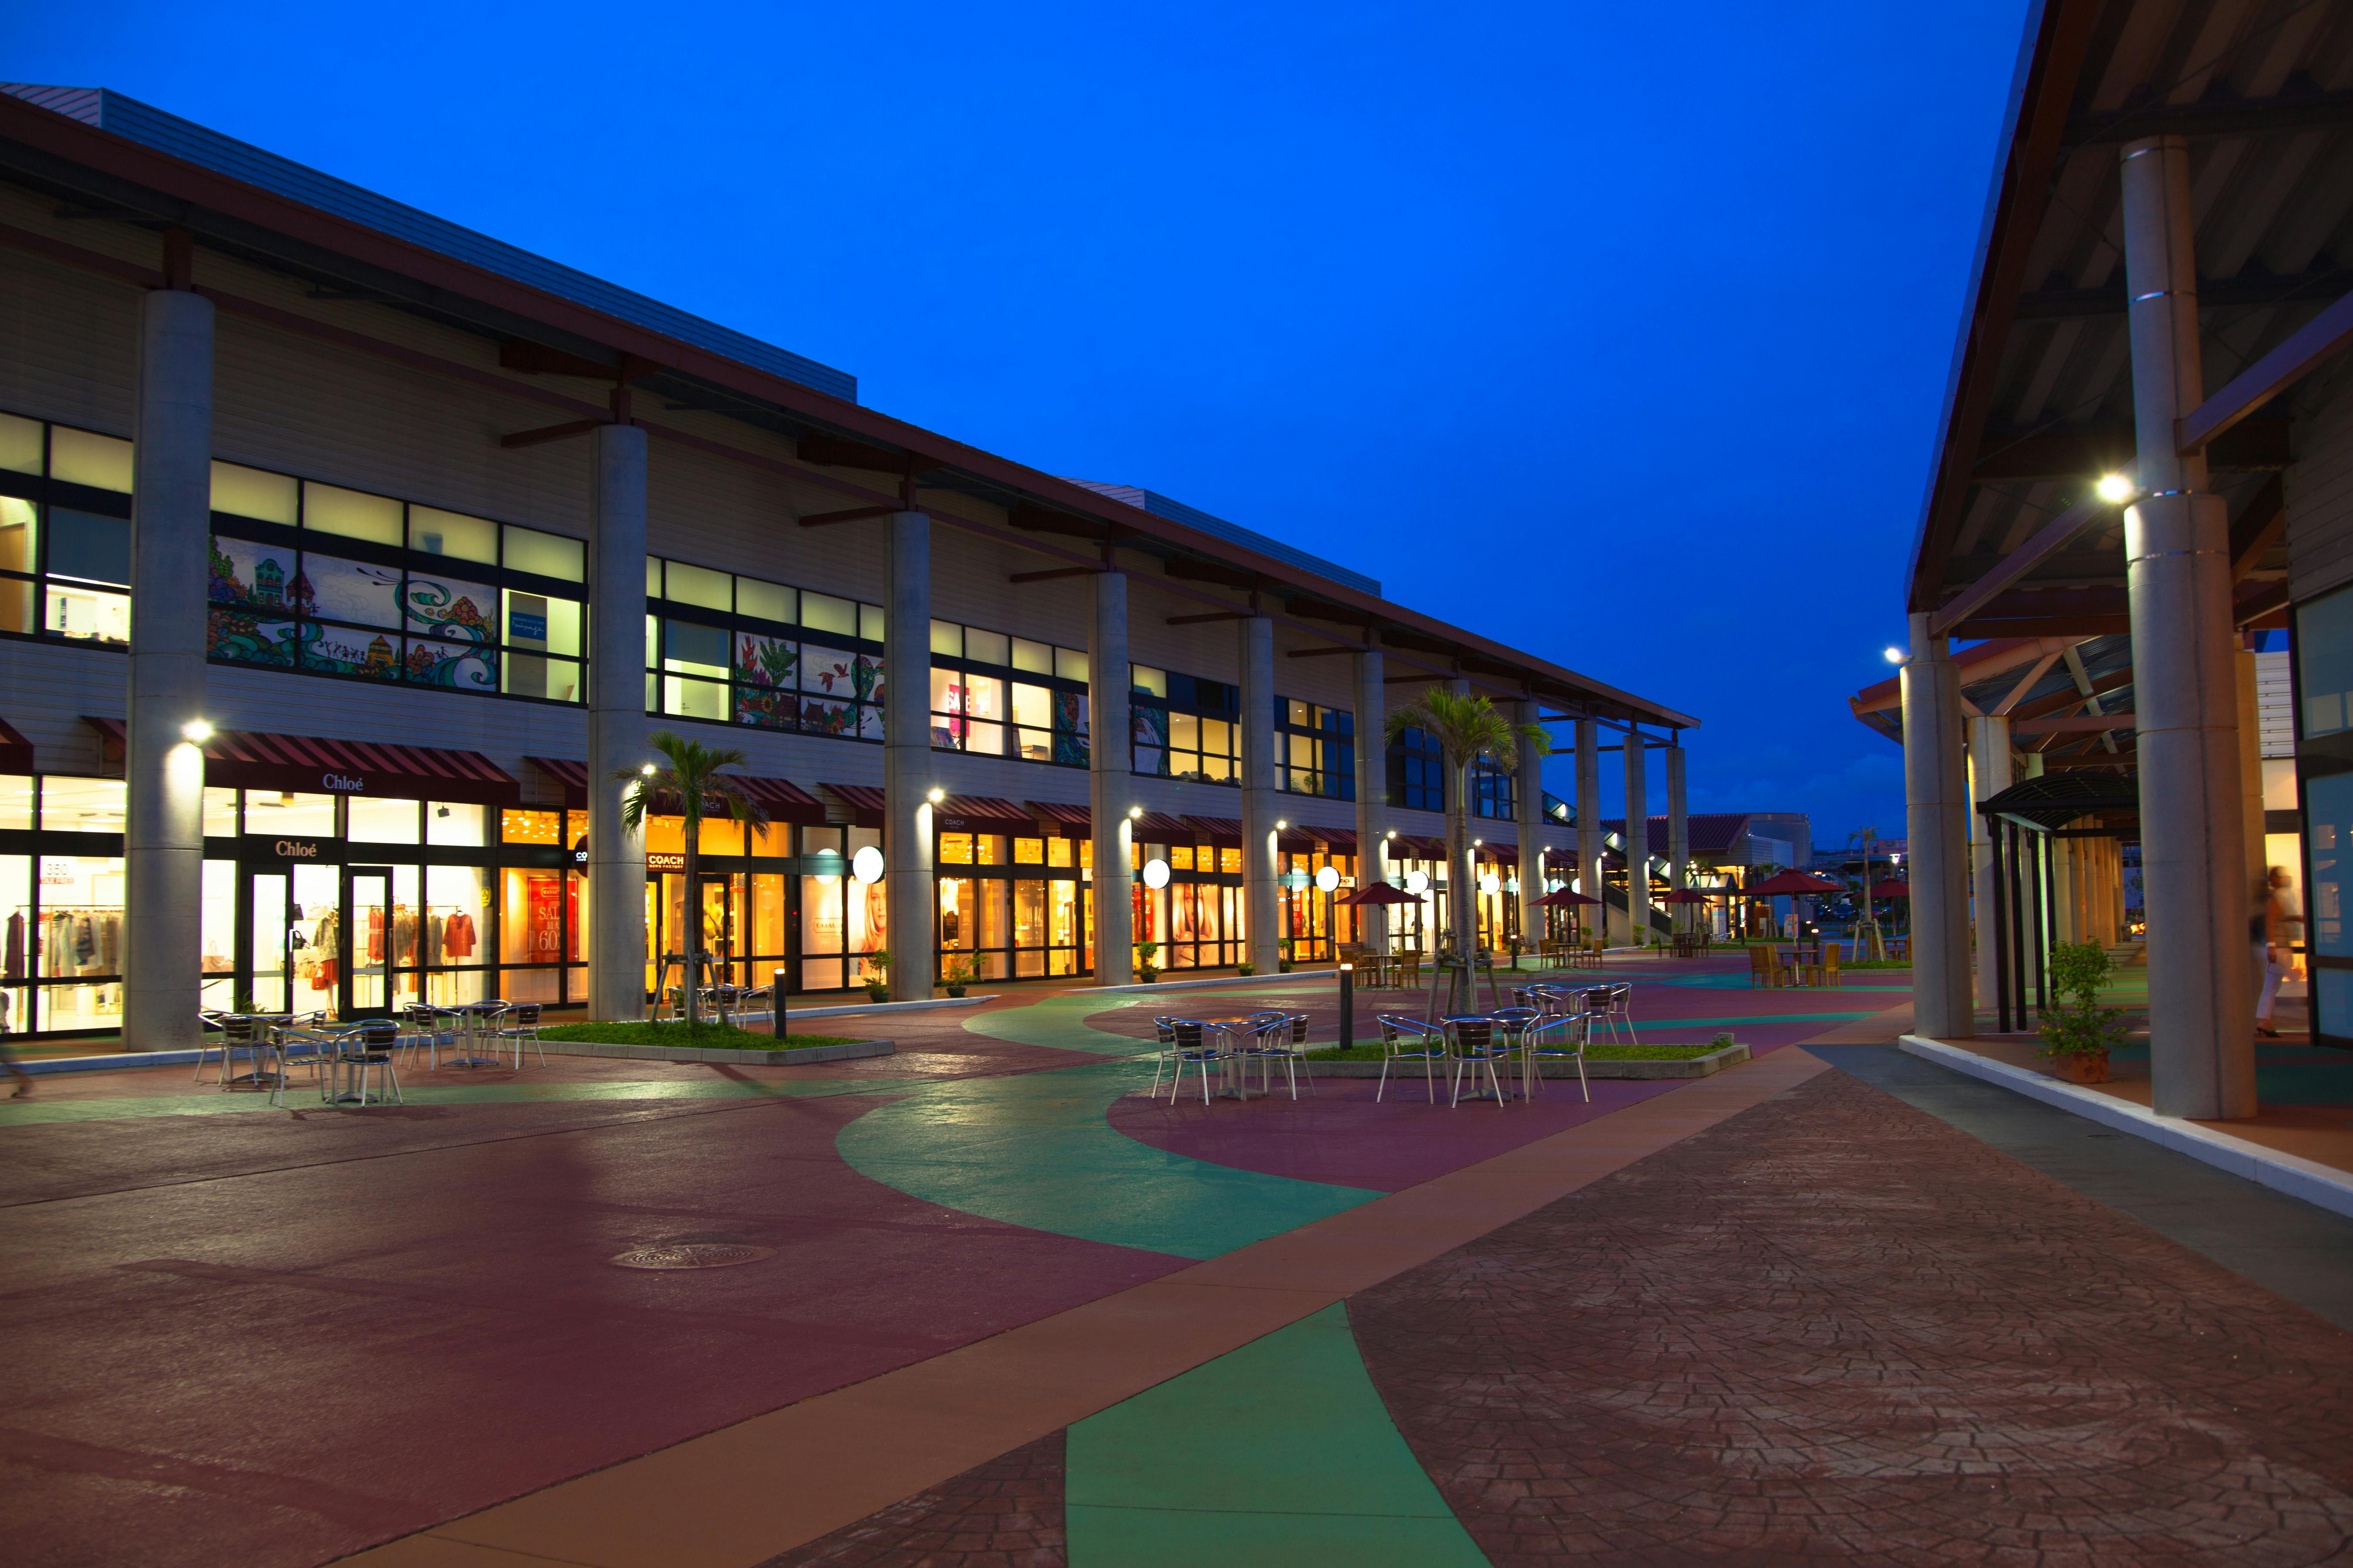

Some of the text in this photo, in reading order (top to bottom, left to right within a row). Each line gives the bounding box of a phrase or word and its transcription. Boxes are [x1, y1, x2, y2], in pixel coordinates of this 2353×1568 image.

[949, 691, 970, 712] SAE
[323, 774, 364, 791] Chloé
[276, 841, 317, 857] Chloé
[648, 855, 684, 865] COACH
[46, 863, 68, 875] 350
[539, 907, 560, 920] SAL
[539, 930, 560, 951] 60
